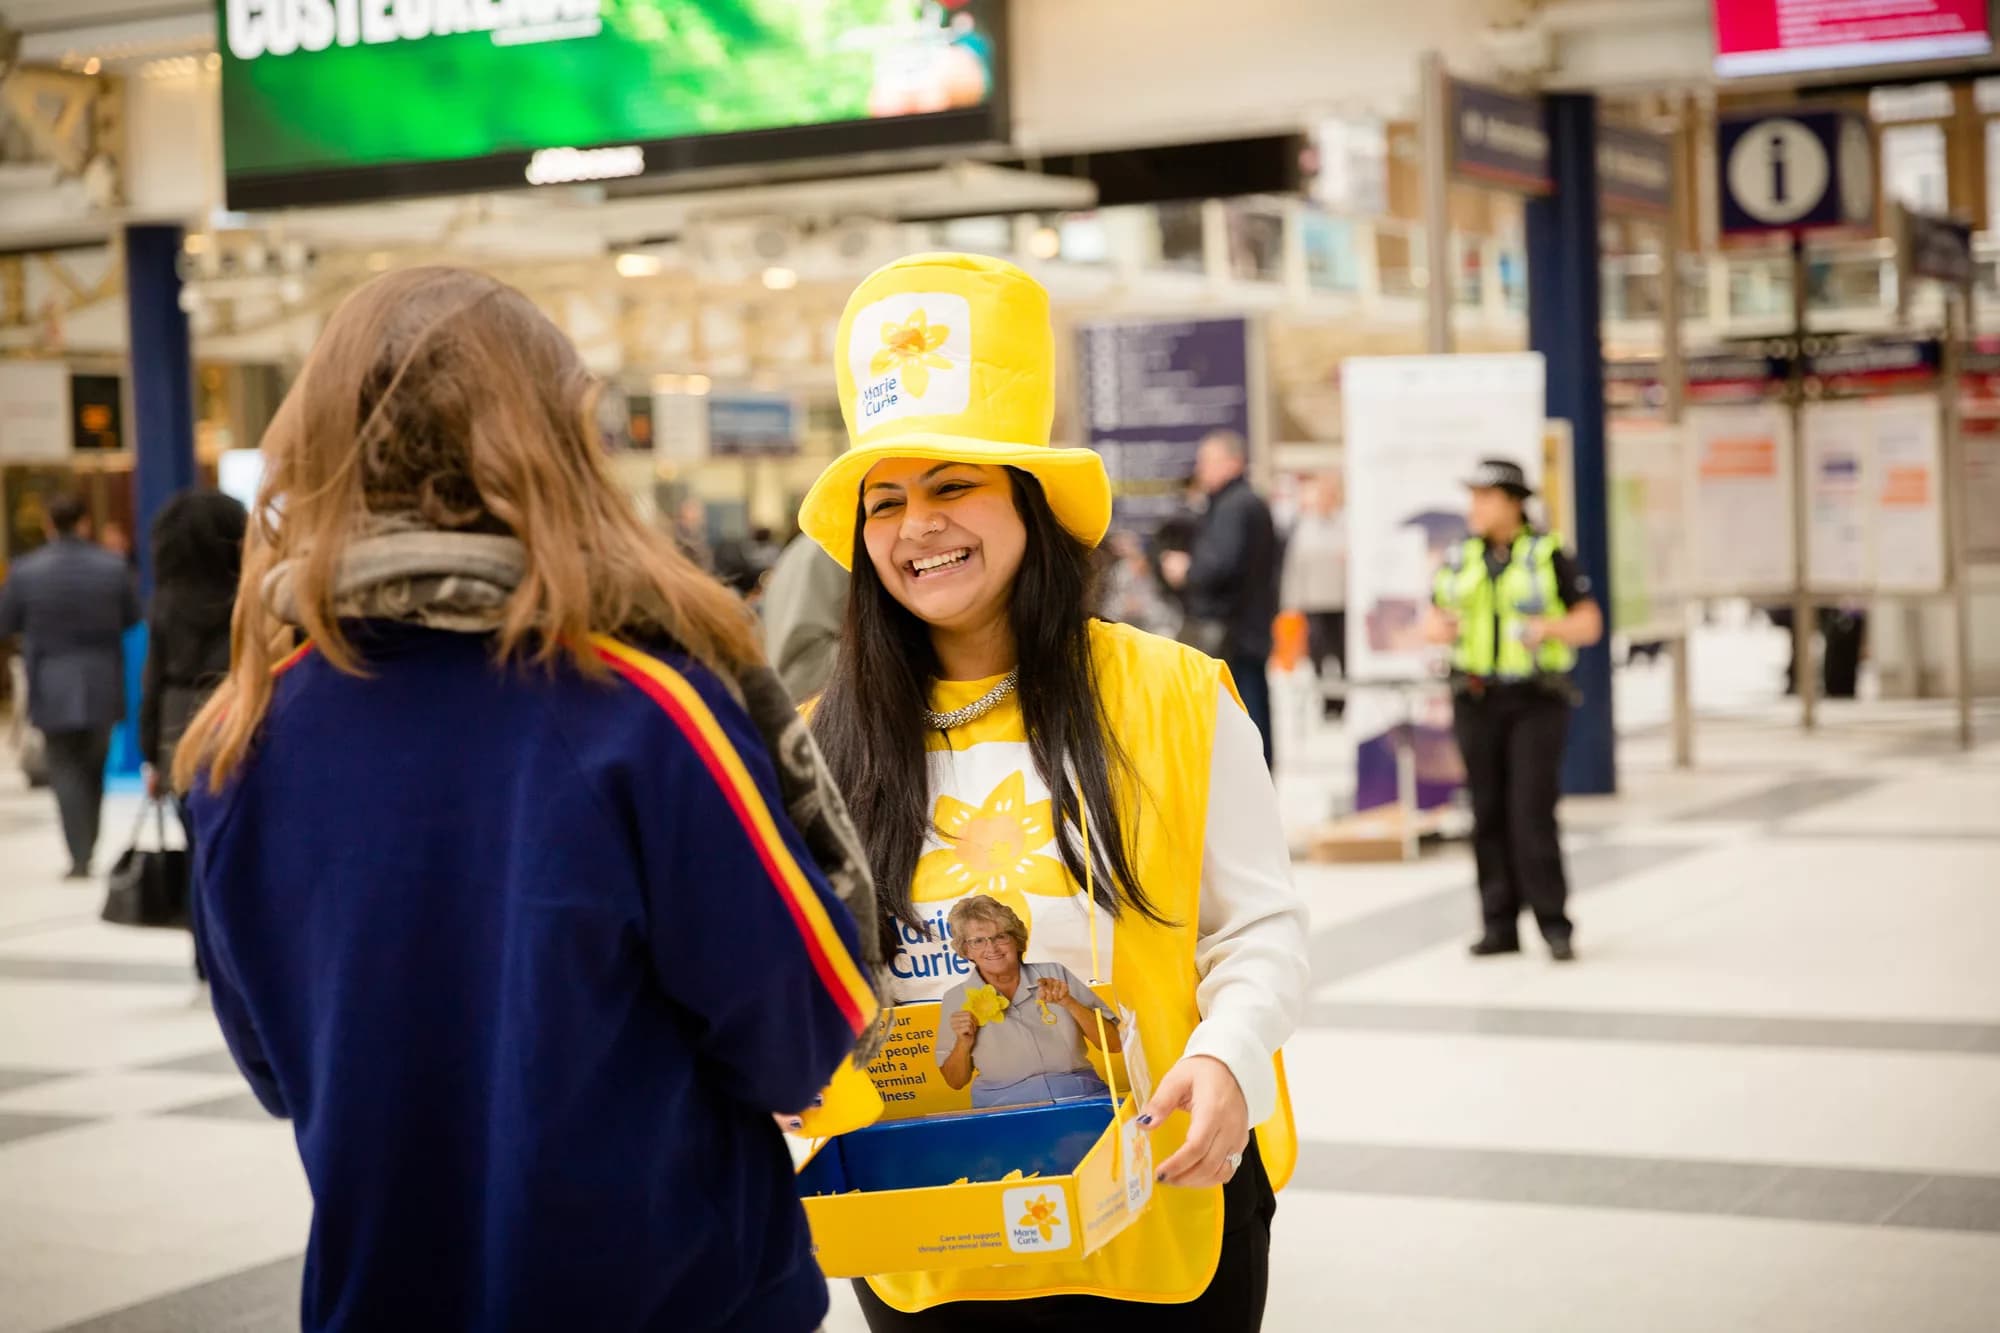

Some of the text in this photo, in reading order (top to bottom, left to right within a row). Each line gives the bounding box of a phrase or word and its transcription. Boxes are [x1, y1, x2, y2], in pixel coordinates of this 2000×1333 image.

[864, 377, 897, 401] Marie
[865, 394, 898, 417] Curie
[888, 944, 970, 979] Curie
[906, 1029, 934, 1041] care
[885, 1043, 930, 1060] people
[867, 1061, 908, 1075] with a
[1014, 1229, 1037, 1238] Marie
[1017, 1236, 1039, 1245] Curie
